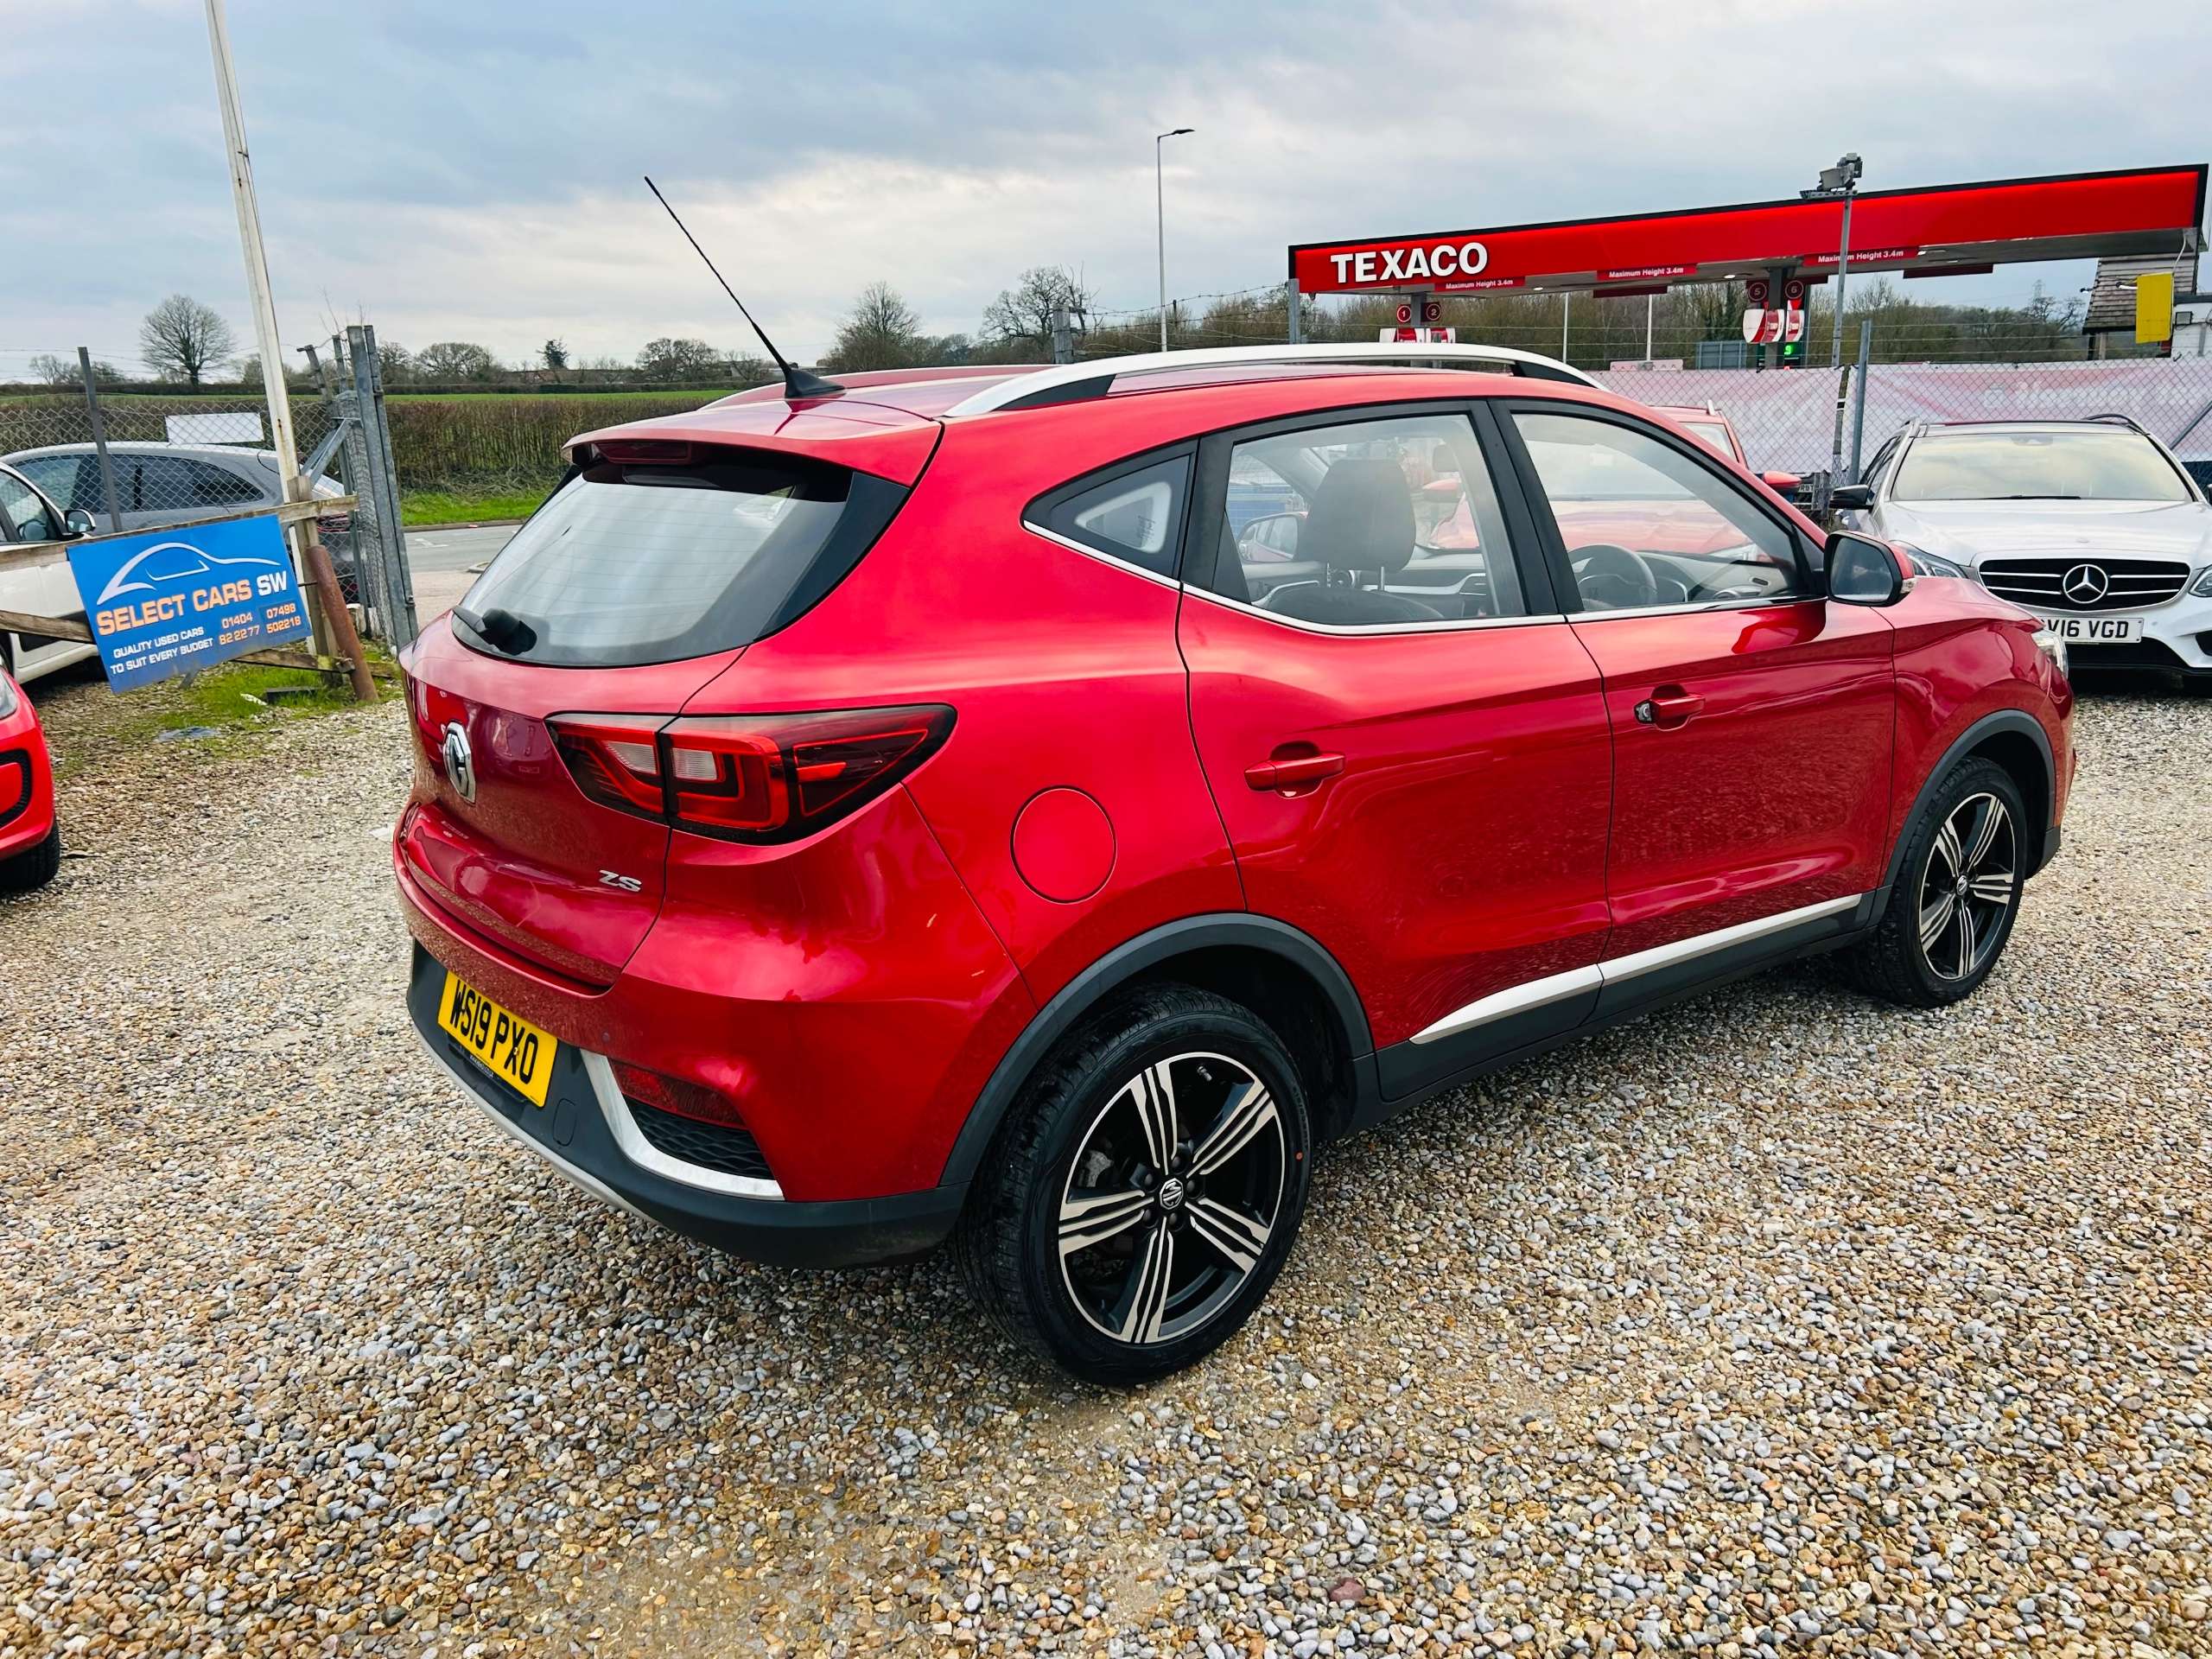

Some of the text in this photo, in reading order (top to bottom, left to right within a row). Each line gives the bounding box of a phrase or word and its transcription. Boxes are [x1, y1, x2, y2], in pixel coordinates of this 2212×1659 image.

[1330, 242, 1488, 283] TEXACO
[1856, 251, 1882, 260] Height
[1642, 268, 1664, 276] Height
[1445, 281, 1474, 289] Maximum
[1476, 280, 1496, 289] Height
[96, 570, 288, 636] SELECT CARS SW
[221, 612, 253, 629] 01404
[2041, 619, 2129, 639] V16 VGD
[113, 626, 205, 658] QUALITY USED CARS
[110, 638, 213, 675] TO SUIT EVERY BUDGET
[599, 869, 642, 893] ZS
[449, 979, 538, 1085] WS19 PXO
